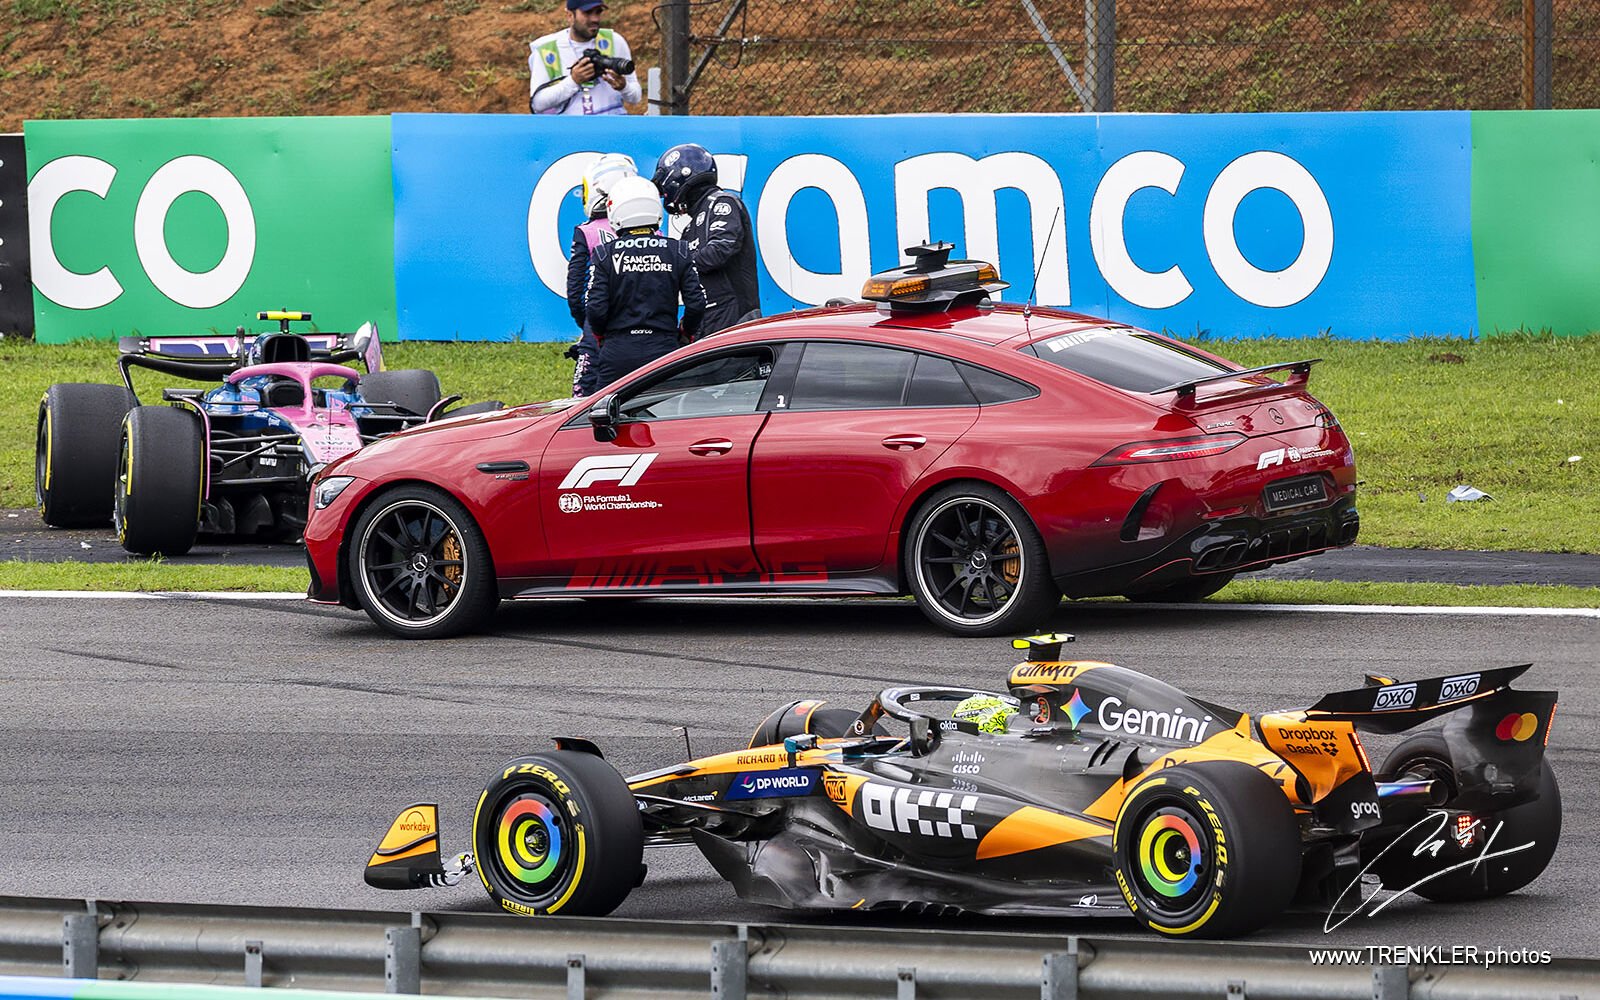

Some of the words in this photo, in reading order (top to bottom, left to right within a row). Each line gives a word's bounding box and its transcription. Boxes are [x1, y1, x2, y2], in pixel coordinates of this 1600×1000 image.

[614, 237, 668, 250] DOCTOR
[623, 254, 662, 264] SANCTA
[622, 262, 673, 273] MAGGIORE
[776, 395, 786, 408] 1
[557, 453, 660, 490] F1
[583, 495, 597, 503] FIA
[597, 494, 626, 503] Formula
[626, 494, 631, 502] 1
[1272, 487, 1303, 502] MEDICAL
[1304, 484, 1319, 496] CAR
[560, 495, 582, 511] FIA
[584, 502, 606, 511] World
[606, 500, 657, 510] Championship
[1017, 663, 1078, 681] allwyn
[1376, 686, 1415, 708] OXXO
[1441, 680, 1478, 699] OXXO
[940, 721, 958, 731] okta
[1098, 696, 1213, 743] Gemini
[1278, 728, 1337, 744] Dropbox
[1286, 743, 1323, 756] Dash
[737, 754, 775, 765] RICHARD
[503, 765, 516, 779] P
[518, 763, 571, 795] ZERO
[756, 778, 771, 789] DP
[771, 775, 809, 789] WORLD
[1351, 801, 1381, 819] groq
[399, 822, 431, 833] workday
[1183, 786, 1200, 797] P
[1197, 798, 1229, 865] ZERO
